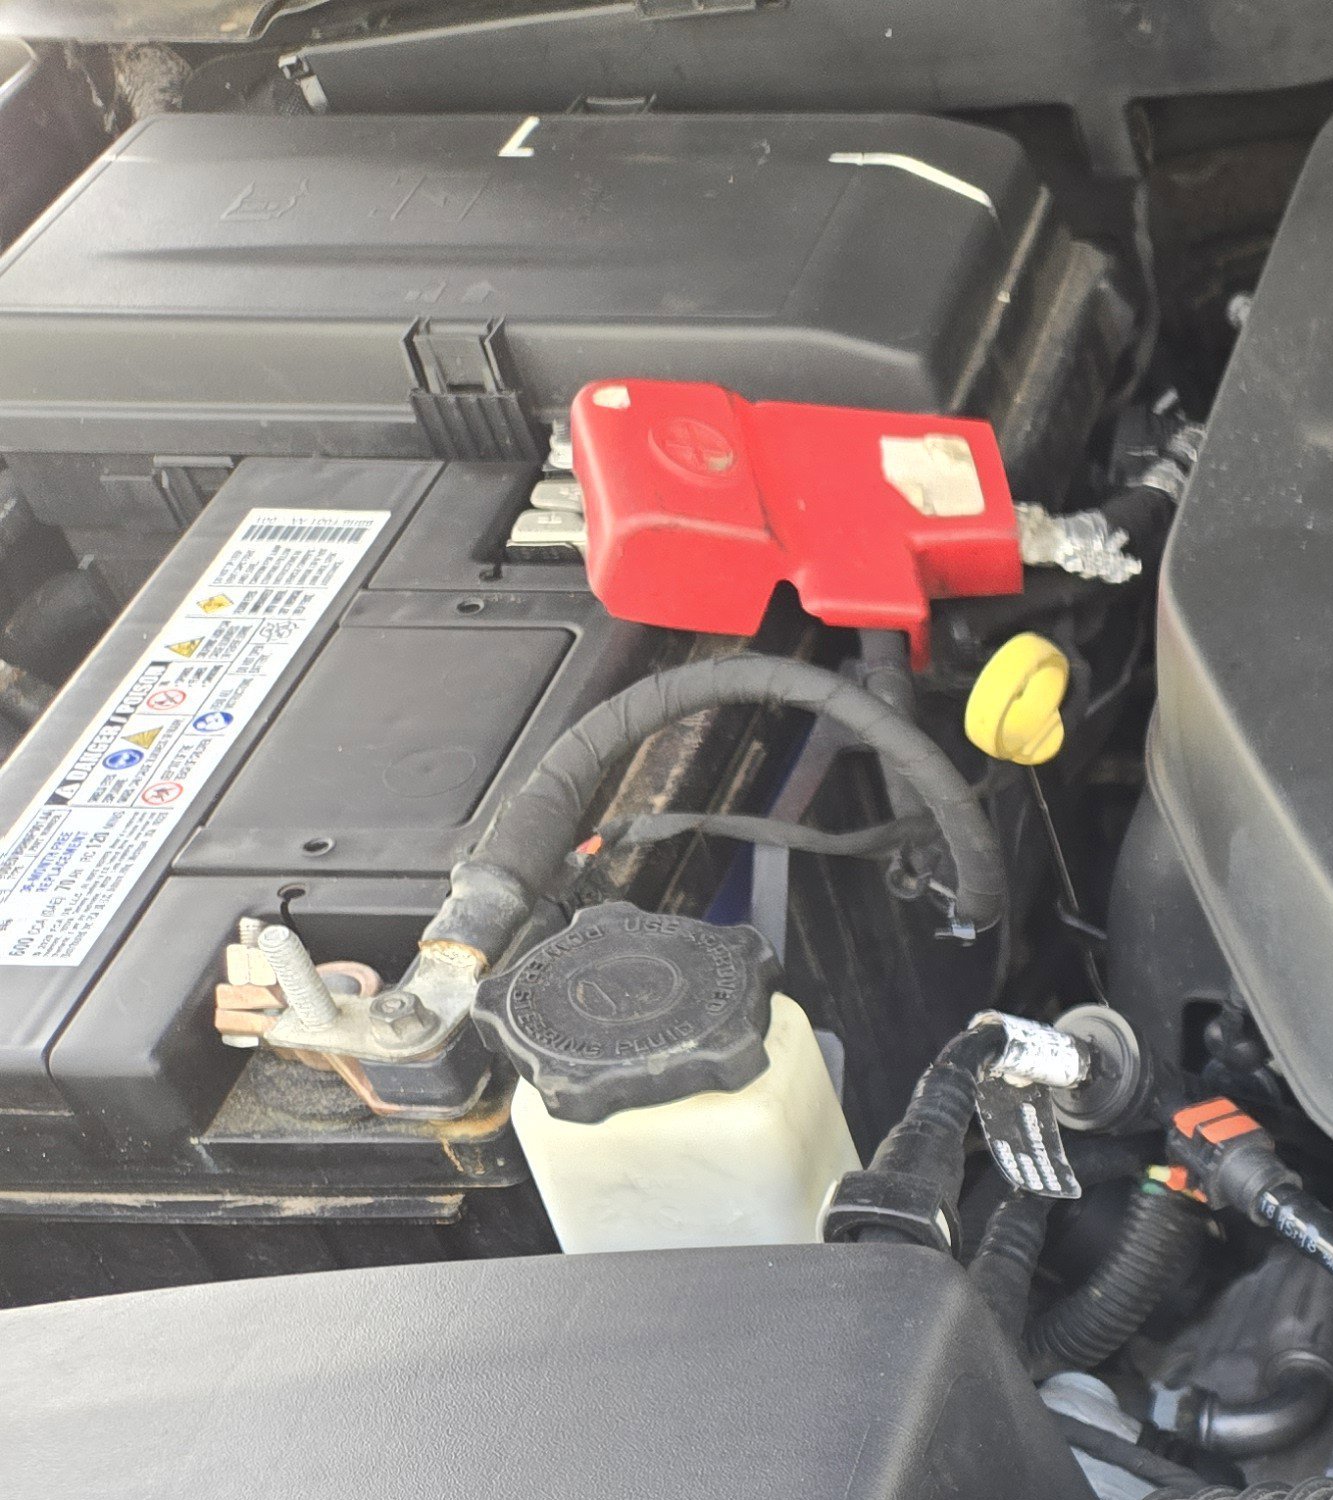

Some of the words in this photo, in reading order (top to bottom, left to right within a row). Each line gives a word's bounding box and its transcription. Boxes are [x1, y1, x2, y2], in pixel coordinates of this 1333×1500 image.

[64, 725, 123, 779] DANGER
[114, 665, 167, 713] POISON
[35, 831, 89, 892] REPLACEMENT
[524, 923, 604, 985] POWER
[623, 916, 681, 936] USE
[513, 988, 603, 1058] STEERING
[614, 1018, 695, 1056] FLUID
